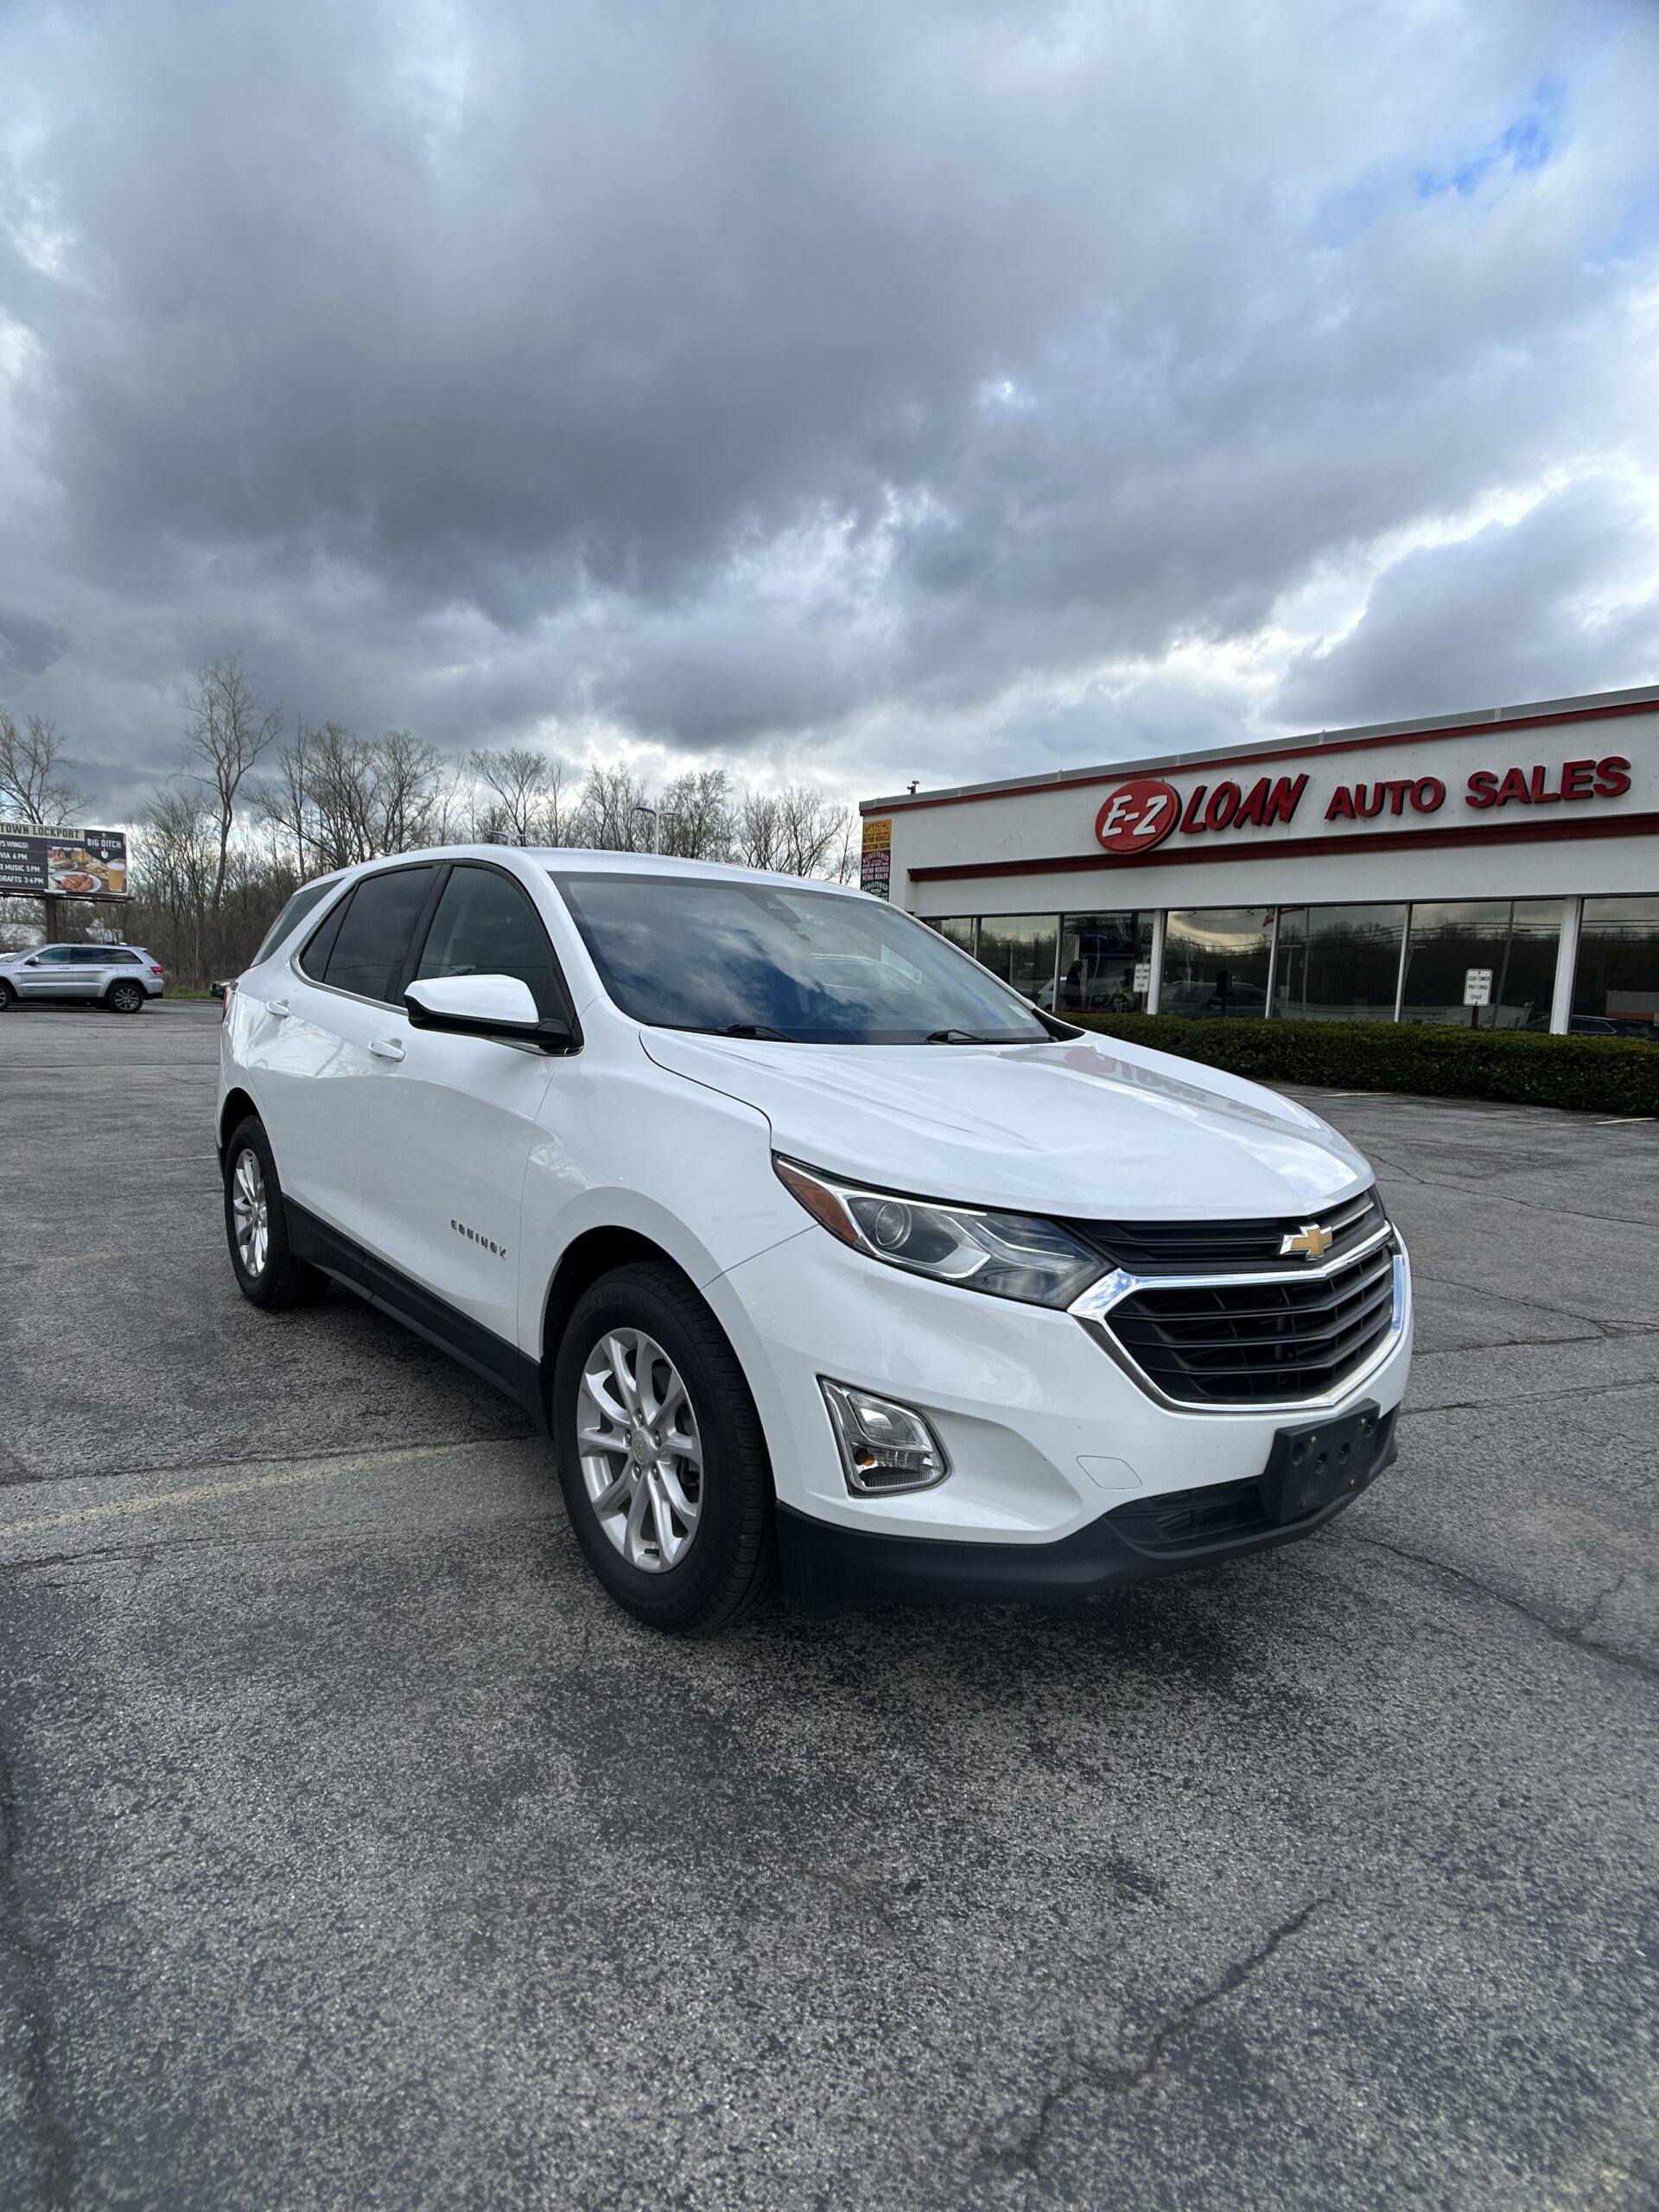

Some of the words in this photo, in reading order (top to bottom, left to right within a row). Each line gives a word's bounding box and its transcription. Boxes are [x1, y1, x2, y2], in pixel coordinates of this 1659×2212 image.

[1102, 794, 1167, 837] E-Z
[1179, 773, 1310, 833] LOAN
[1324, 776, 1446, 821] AUTO
[1465, 756, 1631, 809] SALES
[33, 827, 79, 839] LOCKPORT
[865, 822, 890, 833] OFFICIAL
[87, 838, 99, 847] BIG
[101, 839, 121, 849] DITCH
[862, 851, 889, 862] REGISTERED
[450, 1219, 507, 1260] EQUINOX
